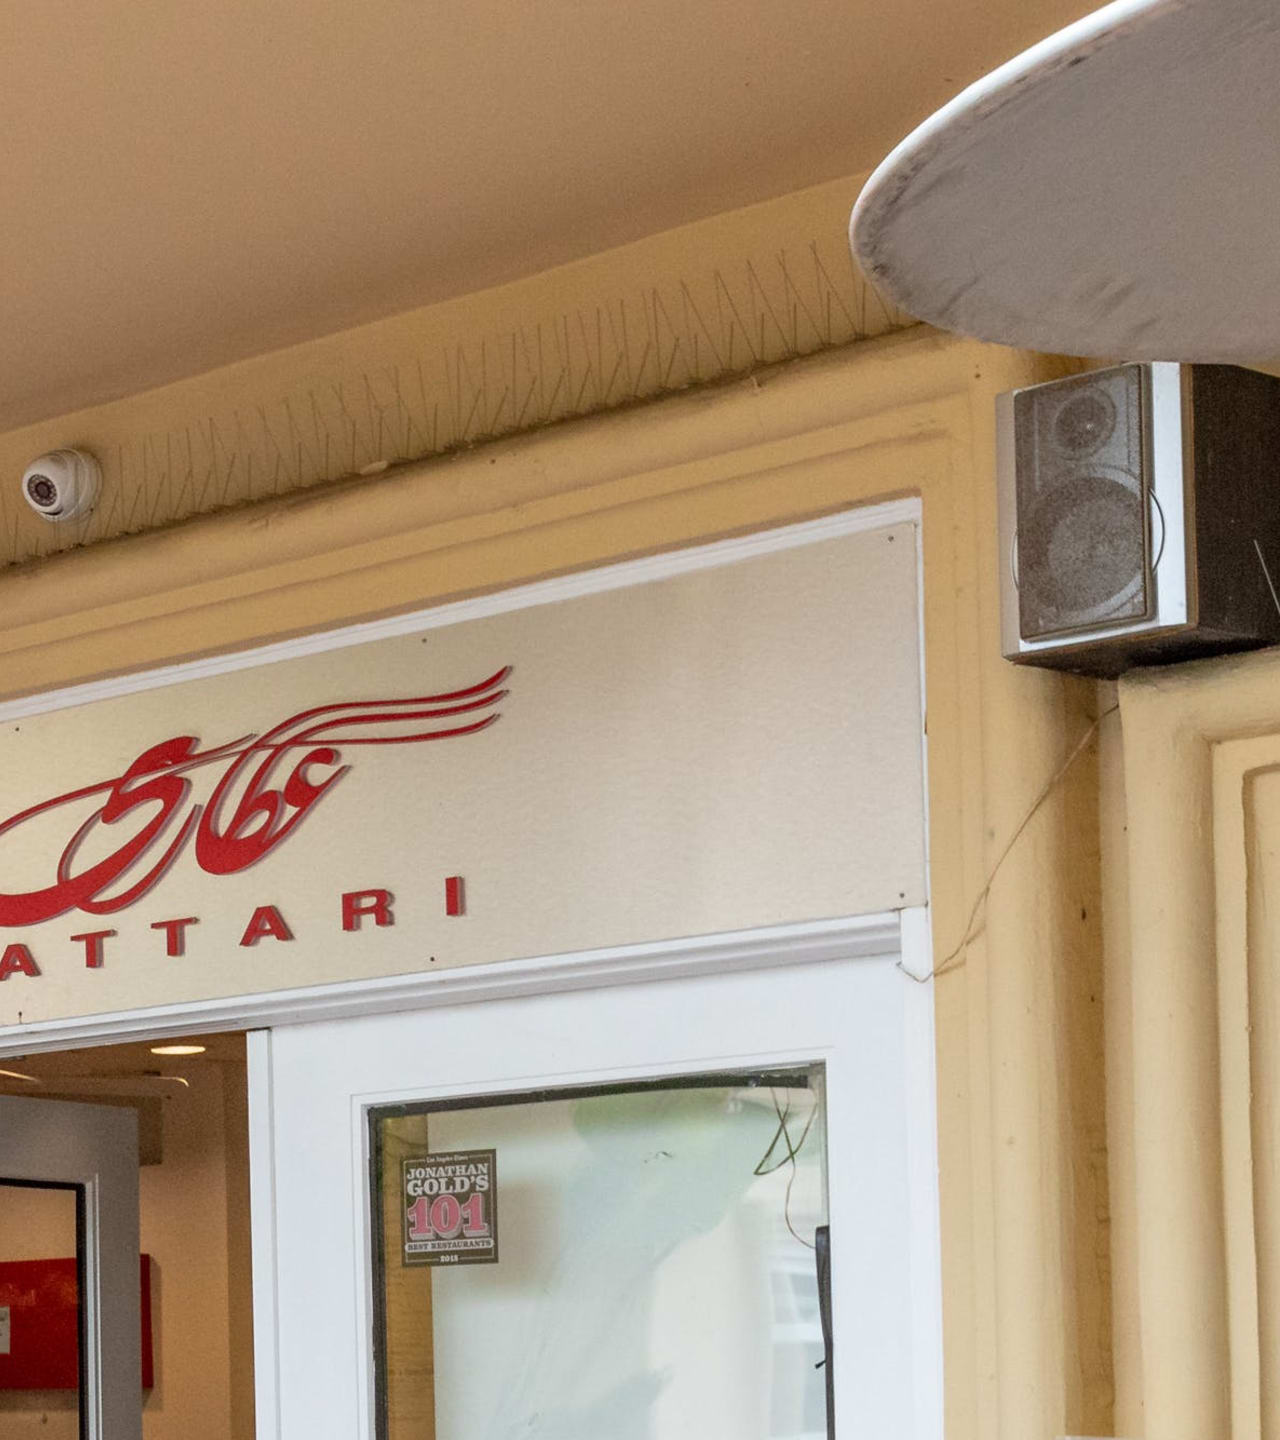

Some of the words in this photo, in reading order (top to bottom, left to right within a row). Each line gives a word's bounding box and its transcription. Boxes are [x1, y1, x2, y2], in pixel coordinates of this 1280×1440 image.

[406, 1162, 489, 1180] JONATHAN
[406, 1174, 490, 1197] GOLD'S
[407, 1192, 490, 1241] 101
[431, 1239, 491, 1250] RESTAURANTS
